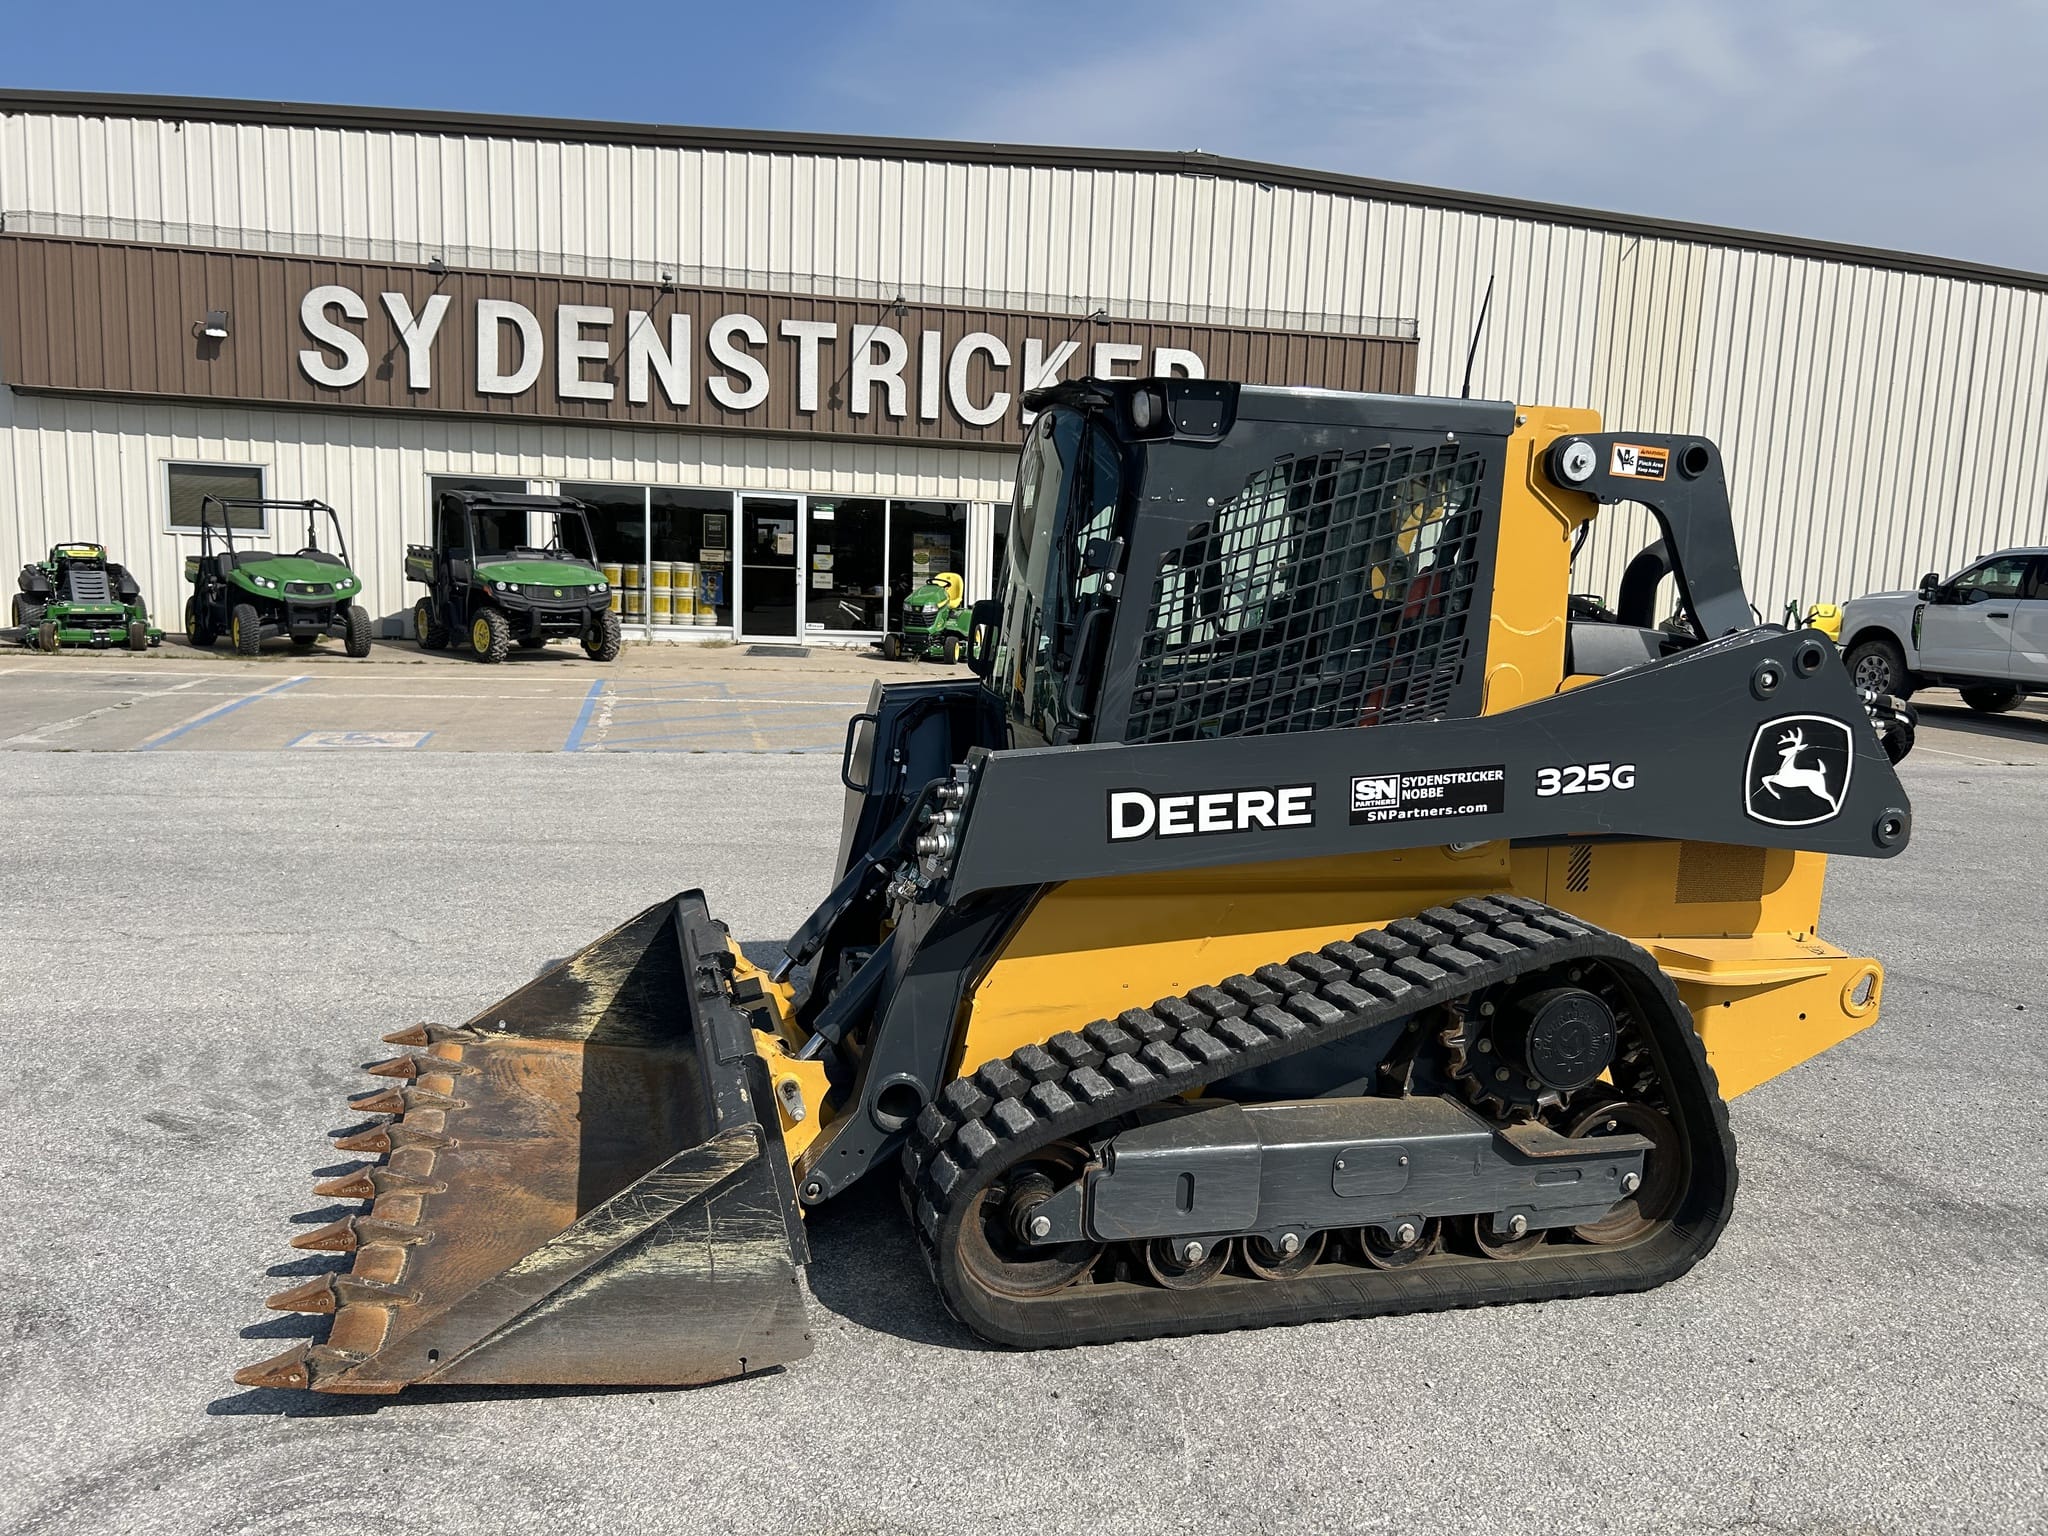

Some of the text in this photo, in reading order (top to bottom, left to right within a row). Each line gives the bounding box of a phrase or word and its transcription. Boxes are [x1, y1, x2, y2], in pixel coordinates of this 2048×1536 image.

[1401, 770, 1504, 788] SYDENSTRICKER
[1536, 763, 1635, 796] 325G
[1355, 779, 1397, 800] SN
[1401, 787, 1444, 800] NOBBE
[1111, 786, 1312, 839] DEERE
[1355, 799, 1396, 808] PARTNERS
[1367, 804, 1488, 821] SNPartners.com
